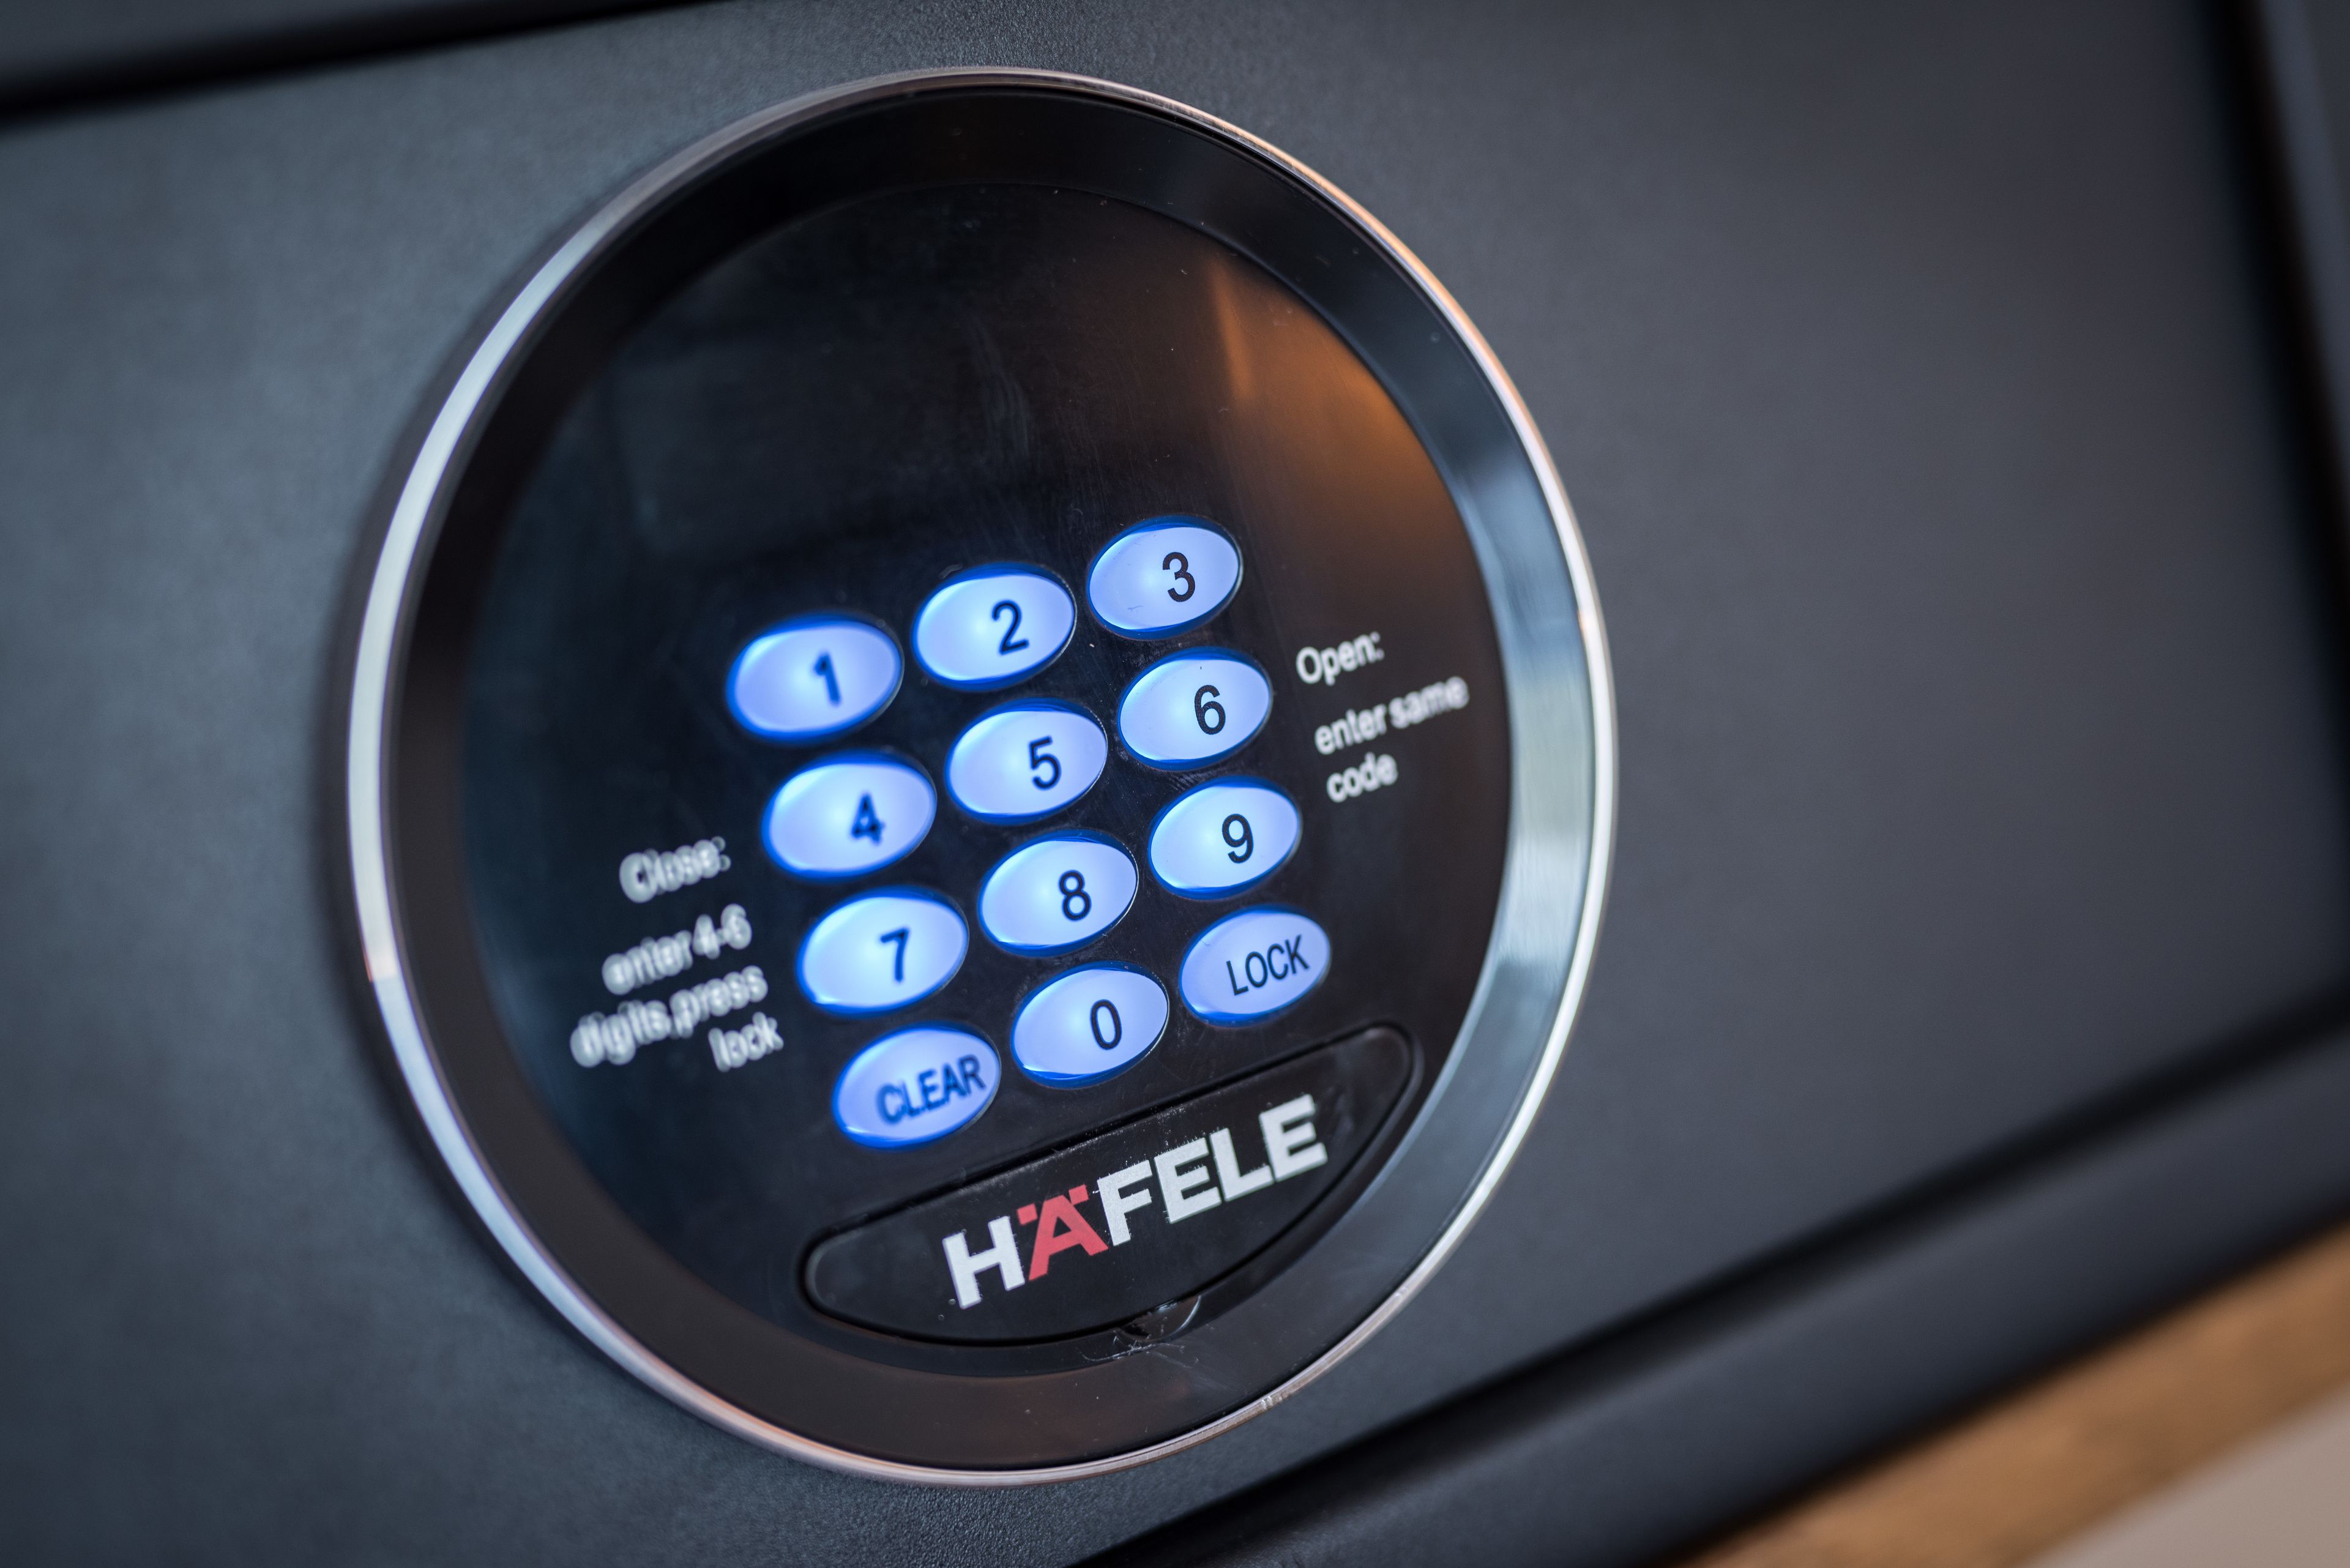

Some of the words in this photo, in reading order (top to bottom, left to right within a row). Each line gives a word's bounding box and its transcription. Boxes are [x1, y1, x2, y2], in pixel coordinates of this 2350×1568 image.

[1162, 551, 1196, 603] 3
[991, 600, 1029, 655] 2
[812, 651, 841, 705] 1
[1296, 631, 1384, 686] Open:
[1195, 684, 1226, 735] 6
[1315, 704, 1387, 755] enter
[1389, 676, 1469, 729] same
[1028, 736, 1061, 790] 5
[1327, 752, 1398, 802] code
[851, 793, 885, 843] 4
[1222, 813, 1253, 864] 9
[619, 836, 731, 903] Close:
[1059, 870, 1092, 920] 8
[602, 930, 693, 995] enter
[692, 903, 752, 960] 4-6
[880, 928, 910, 982] 7
[1226, 935, 1310, 996] LOCK
[570, 999, 672, 1068] digits
[670, 965, 768, 1039] press
[708, 1012, 784, 1072] lock
[875, 1055, 987, 1125] CLEAR
[942, 1094, 1327, 1309] HÄFELE
